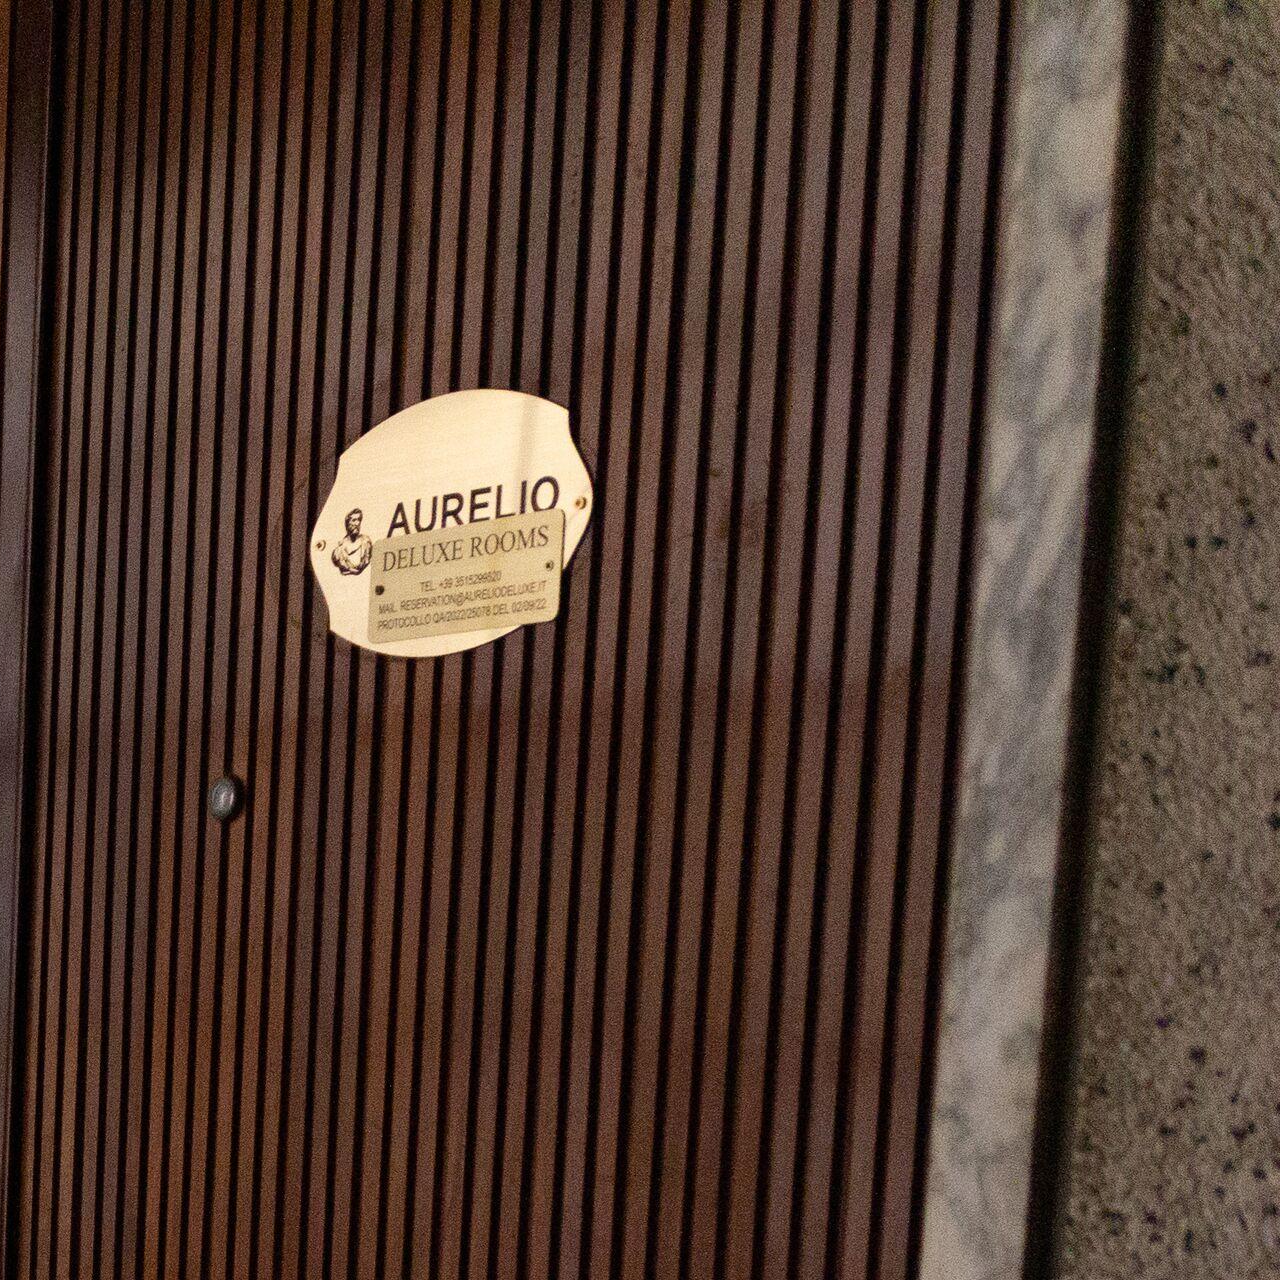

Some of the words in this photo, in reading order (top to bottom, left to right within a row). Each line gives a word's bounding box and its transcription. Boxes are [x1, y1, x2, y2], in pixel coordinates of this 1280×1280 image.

[387, 475, 560, 538] AURELIO
[383, 536, 463, 572] DELUXE
[470, 525, 549, 557] ROOMS
[493, 602, 510, 616] DEL
